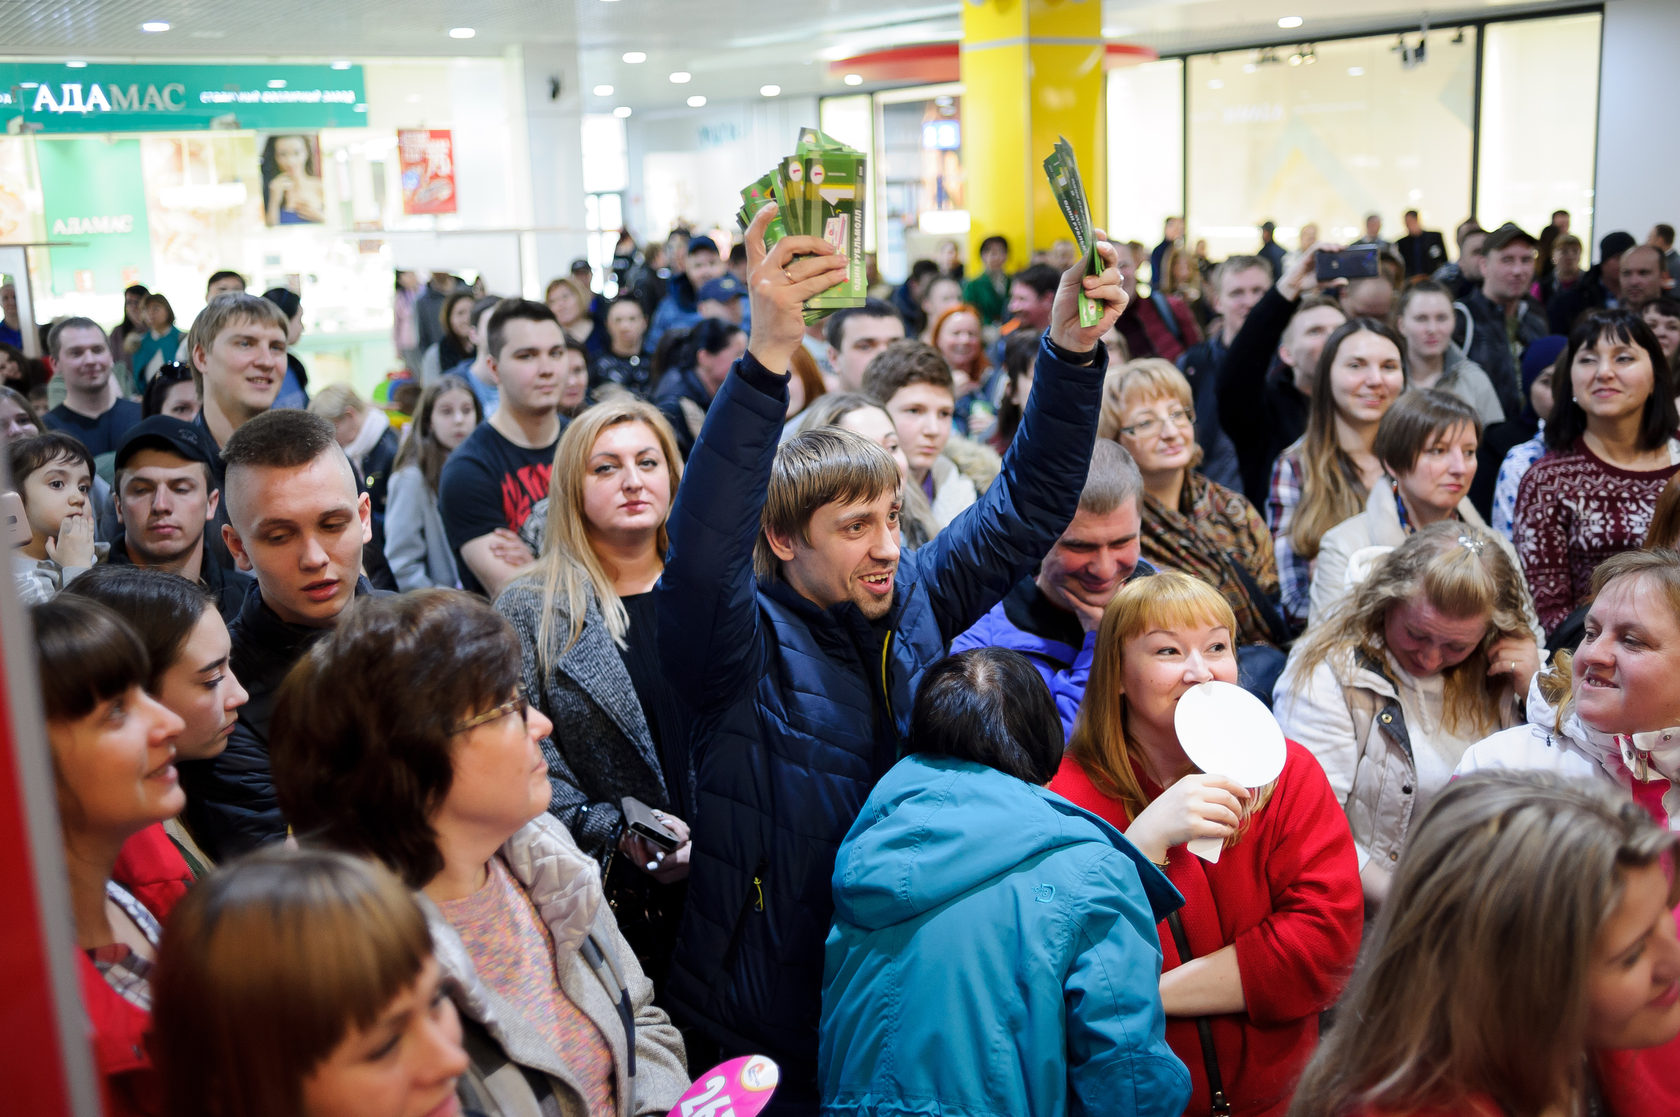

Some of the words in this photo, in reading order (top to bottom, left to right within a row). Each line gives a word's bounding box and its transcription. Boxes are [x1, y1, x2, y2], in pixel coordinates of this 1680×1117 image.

[32, 83, 187, 114] АДАМАС
[53, 214, 134, 235] АДАМАС
[854, 265, 863, 292] ОДИН
